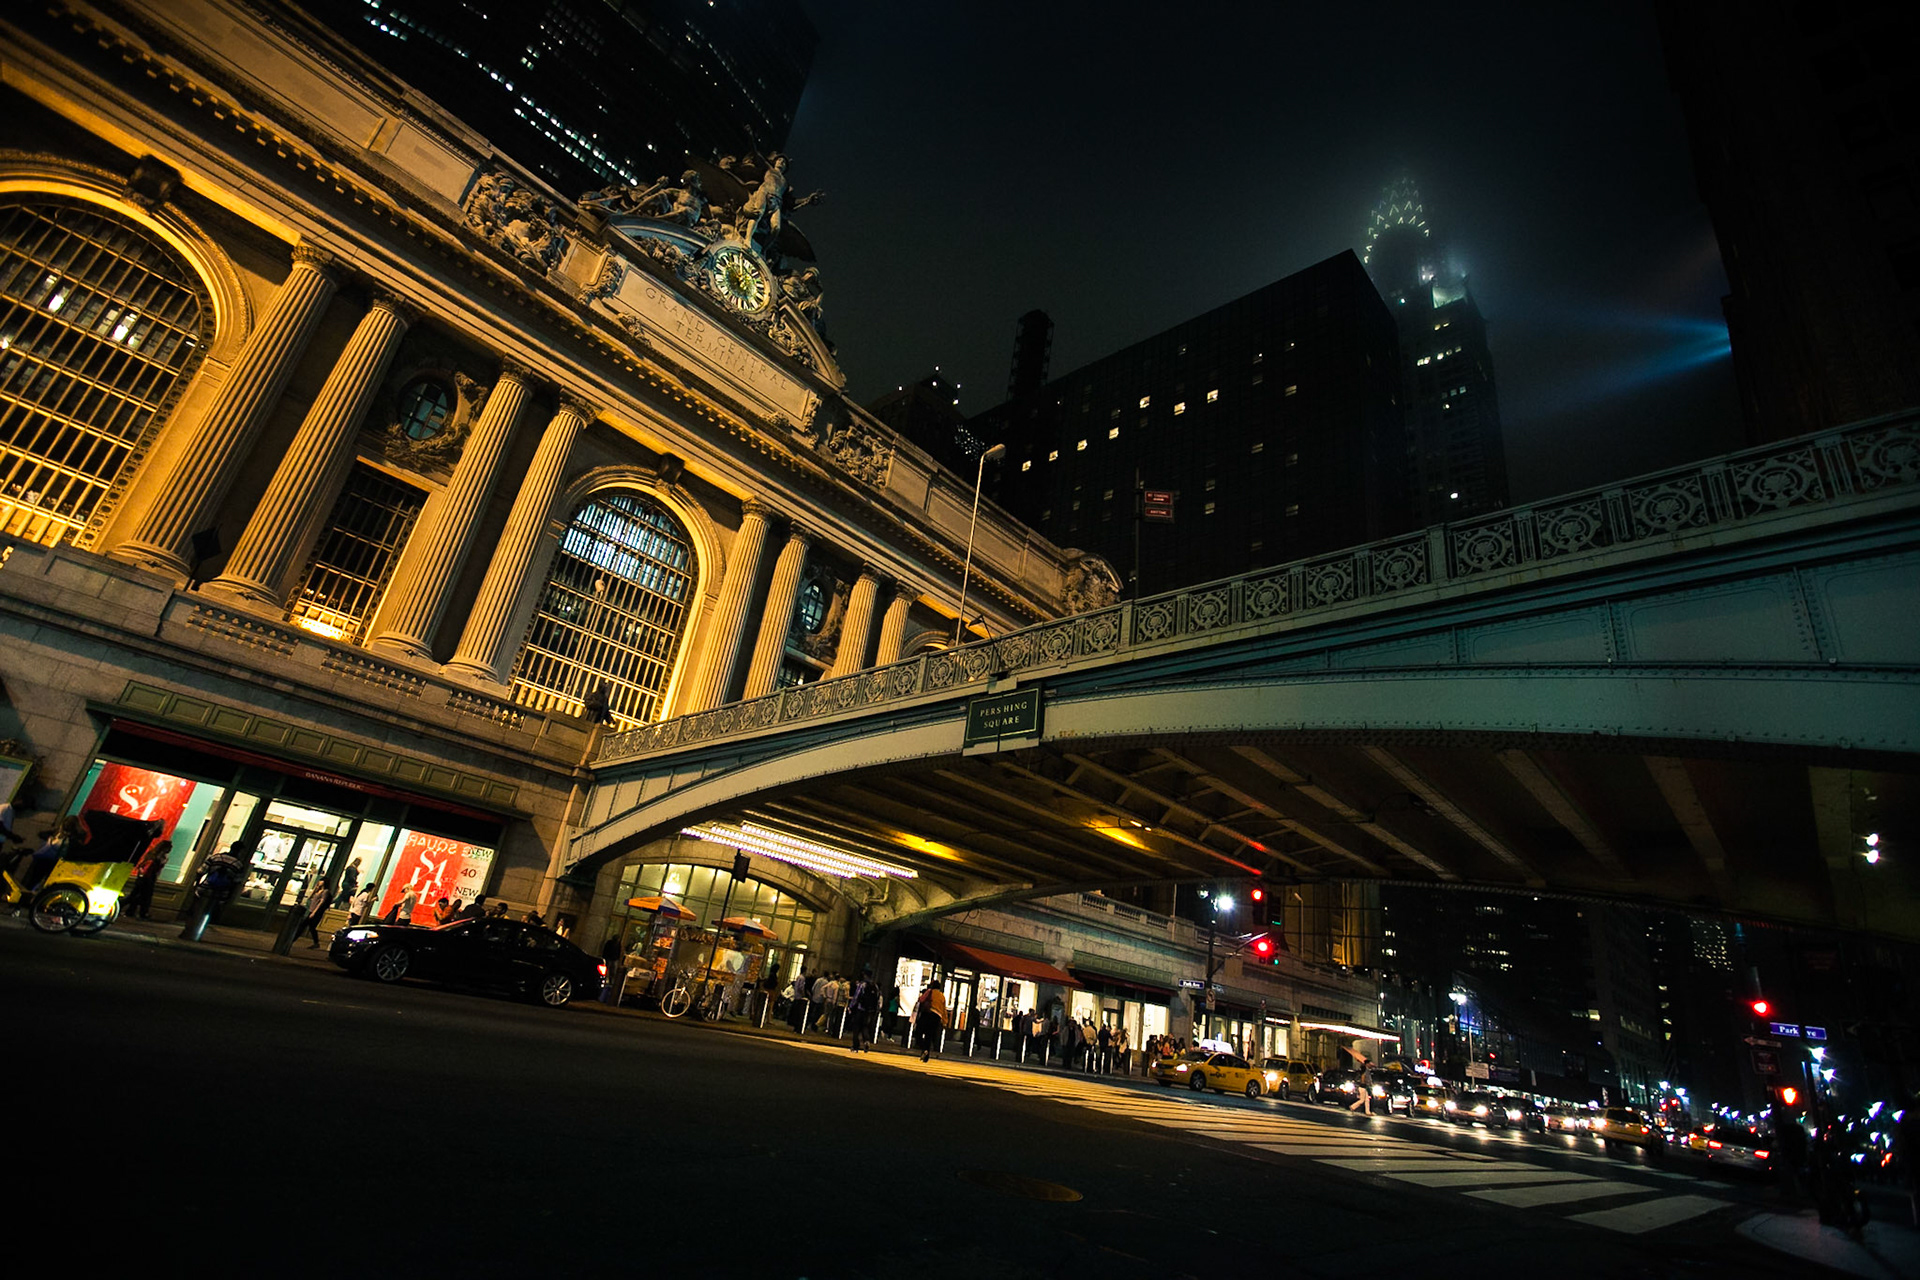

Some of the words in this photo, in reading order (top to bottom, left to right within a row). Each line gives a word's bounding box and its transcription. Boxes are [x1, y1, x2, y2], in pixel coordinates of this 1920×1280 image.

[645, 287, 706, 333] GRAND
[717, 336, 787, 390] CENTRAL
[675, 320, 757, 383] TERMINAL
[980, 701, 1028, 717] PERSHING
[983, 716, 1020, 728] SQUARE
[455, 886, 479, 897] NEW
[1779, 1025, 1798, 1035] Park
